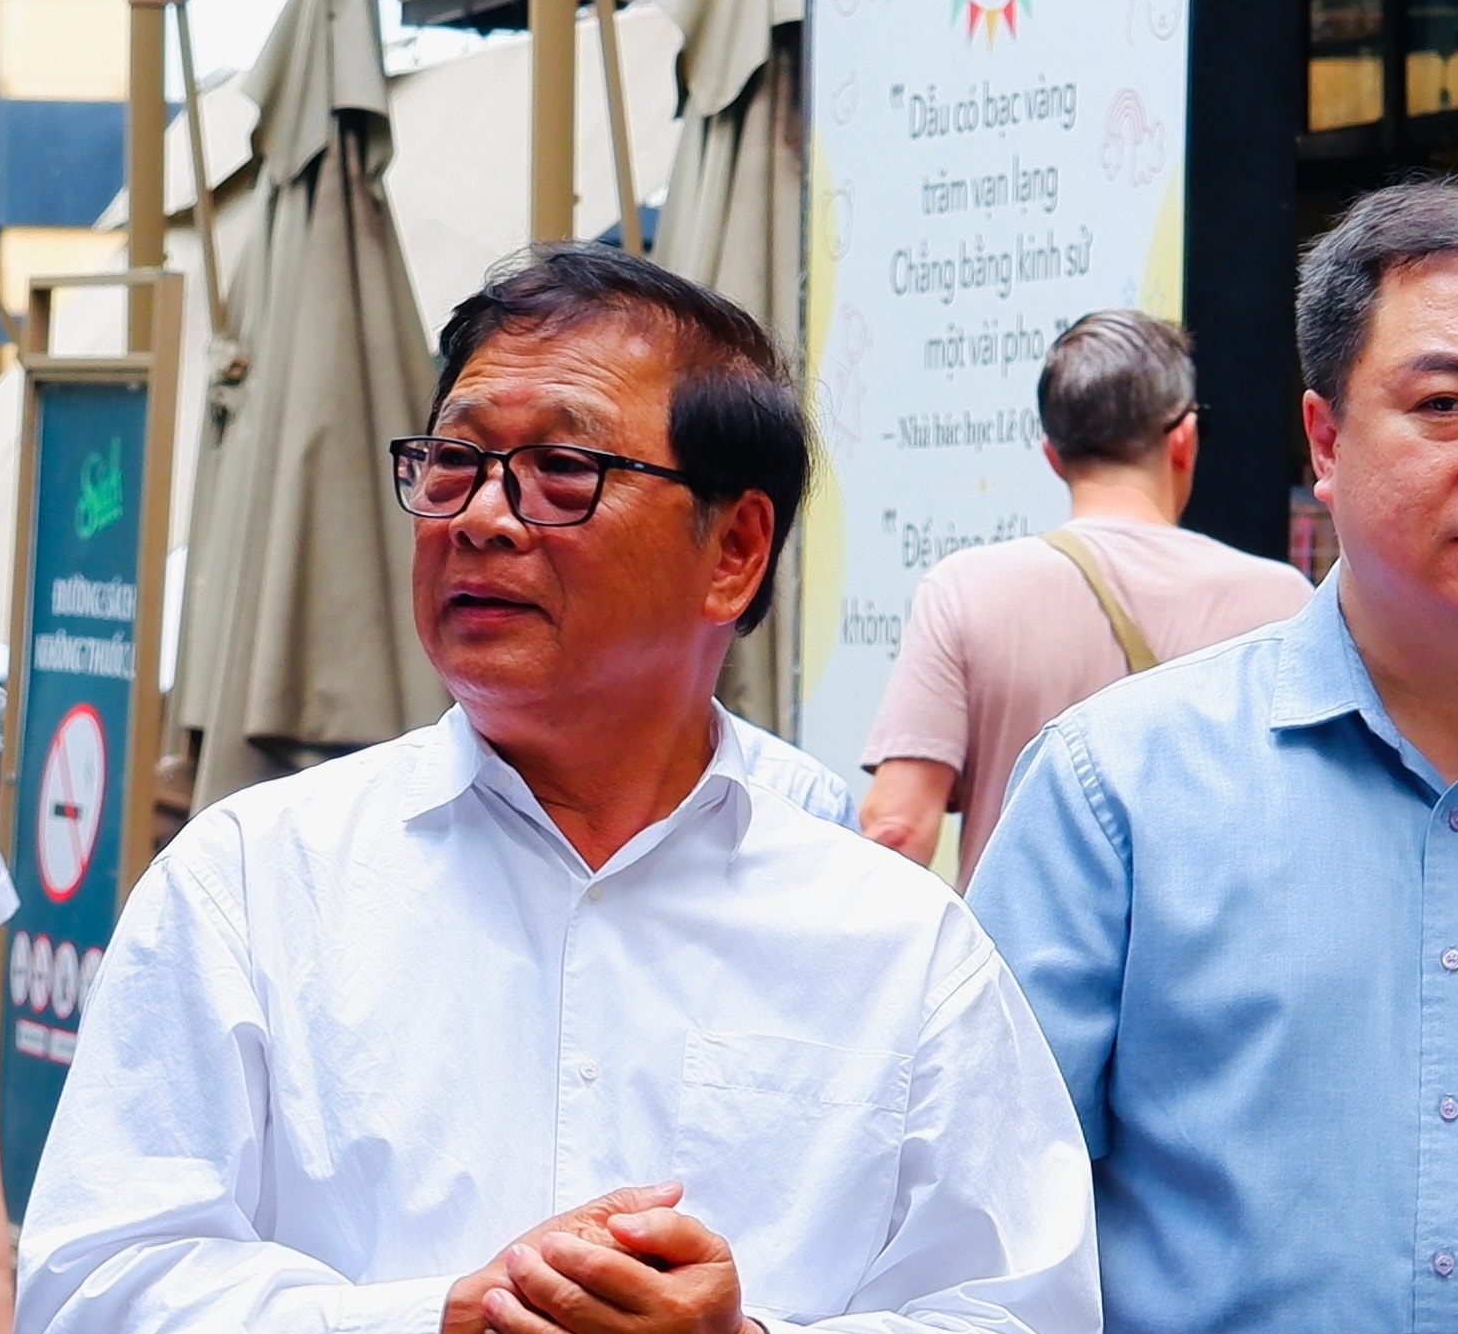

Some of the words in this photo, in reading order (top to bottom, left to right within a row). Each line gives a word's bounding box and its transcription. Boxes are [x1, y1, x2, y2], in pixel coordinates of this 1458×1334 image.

[982, 79, 1020, 139] bạc
[1024, 72, 1077, 131] vàng
[970, 173, 1009, 220] vạn
[1016, 230, 1062, 284] kinh
